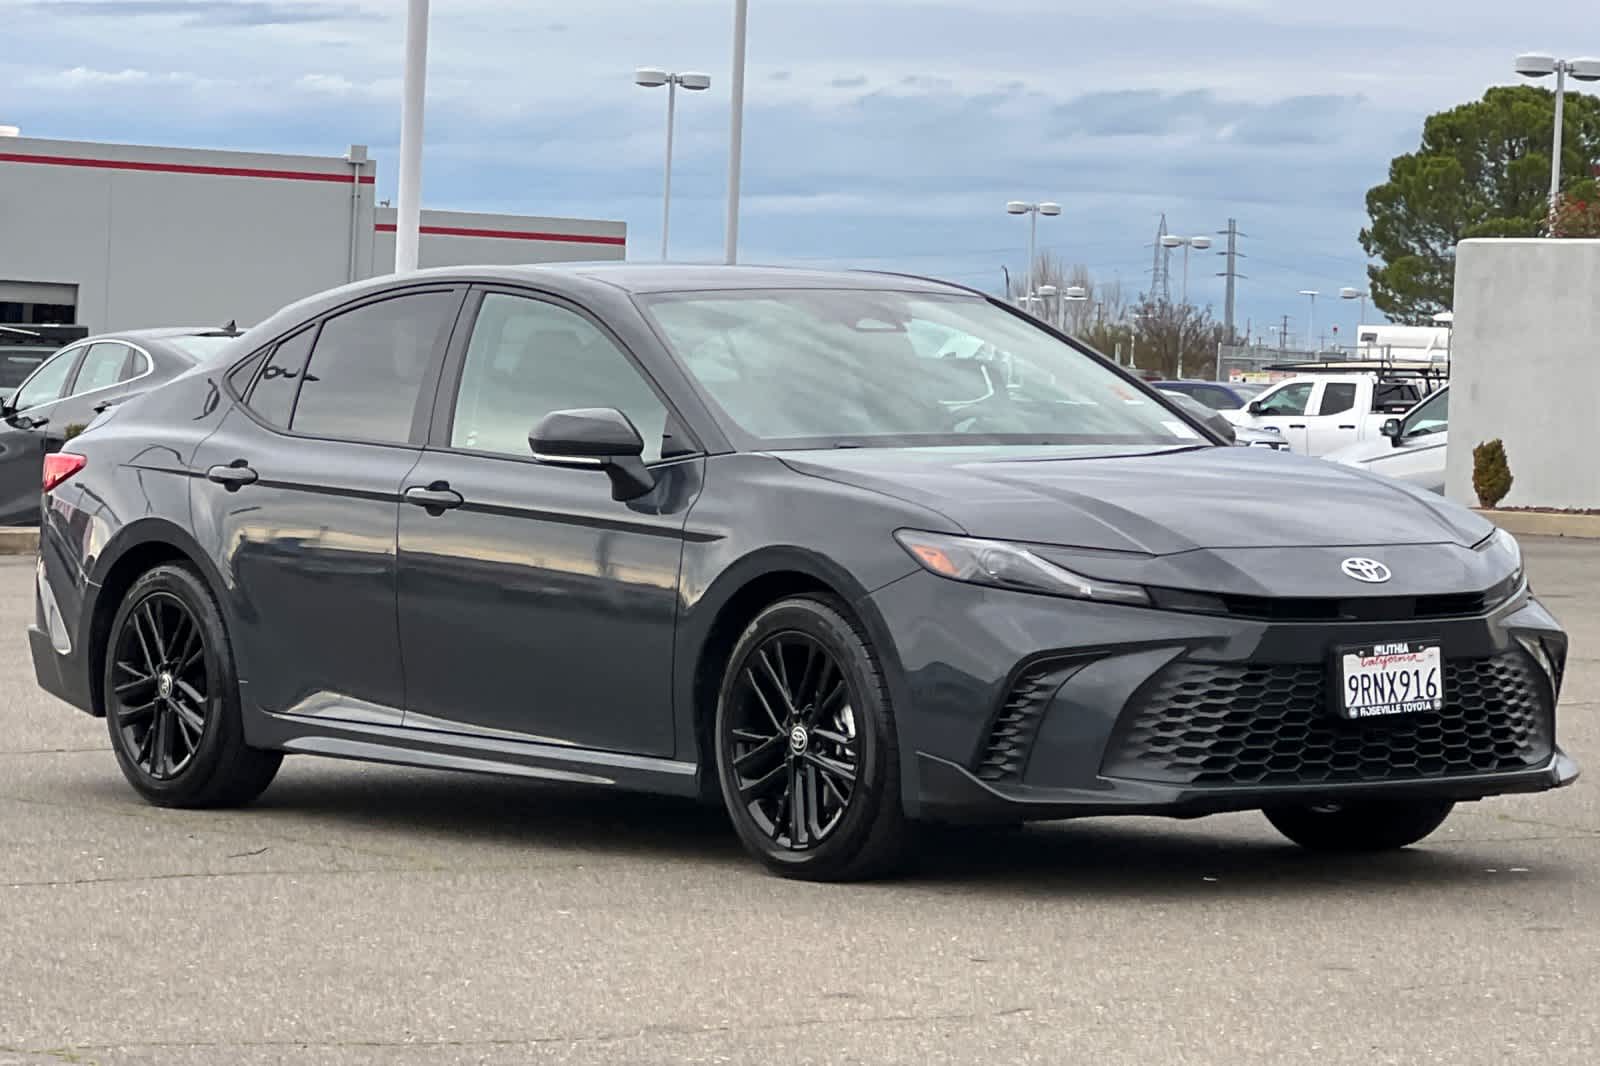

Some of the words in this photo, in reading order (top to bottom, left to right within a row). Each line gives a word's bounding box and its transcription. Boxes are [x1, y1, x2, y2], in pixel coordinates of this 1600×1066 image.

[1359, 654, 1424, 670] California
[1349, 667, 1437, 705] 9RNX916
[1402, 700, 1432, 713] TOYOTA
